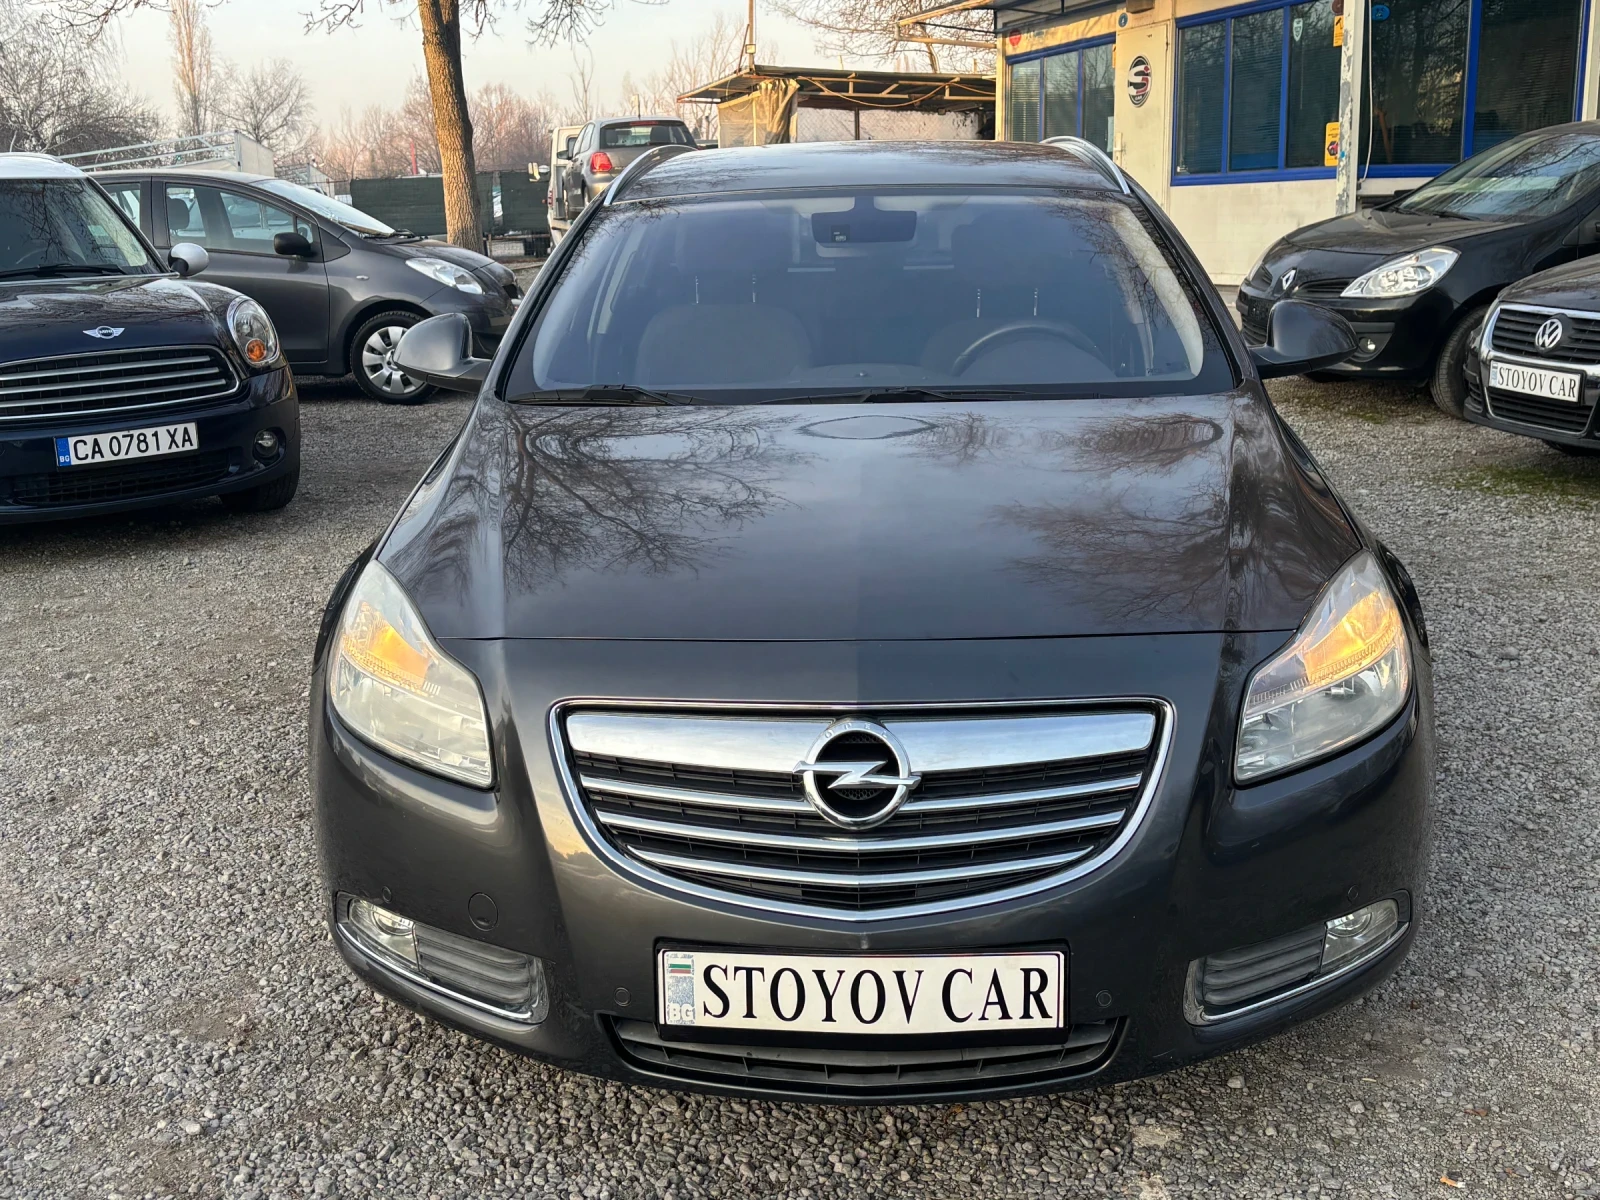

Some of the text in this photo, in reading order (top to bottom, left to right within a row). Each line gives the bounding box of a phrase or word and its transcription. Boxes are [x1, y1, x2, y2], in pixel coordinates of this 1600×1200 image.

[1497, 366, 1547, 392] STOYOV
[1549, 375, 1577, 398] CAR
[59, 455, 70, 463] BG
[73, 426, 194, 461] CA 0781 XA
[703, 964, 1053, 1025] STOYOV CAR
[669, 1003, 694, 1021] BG
